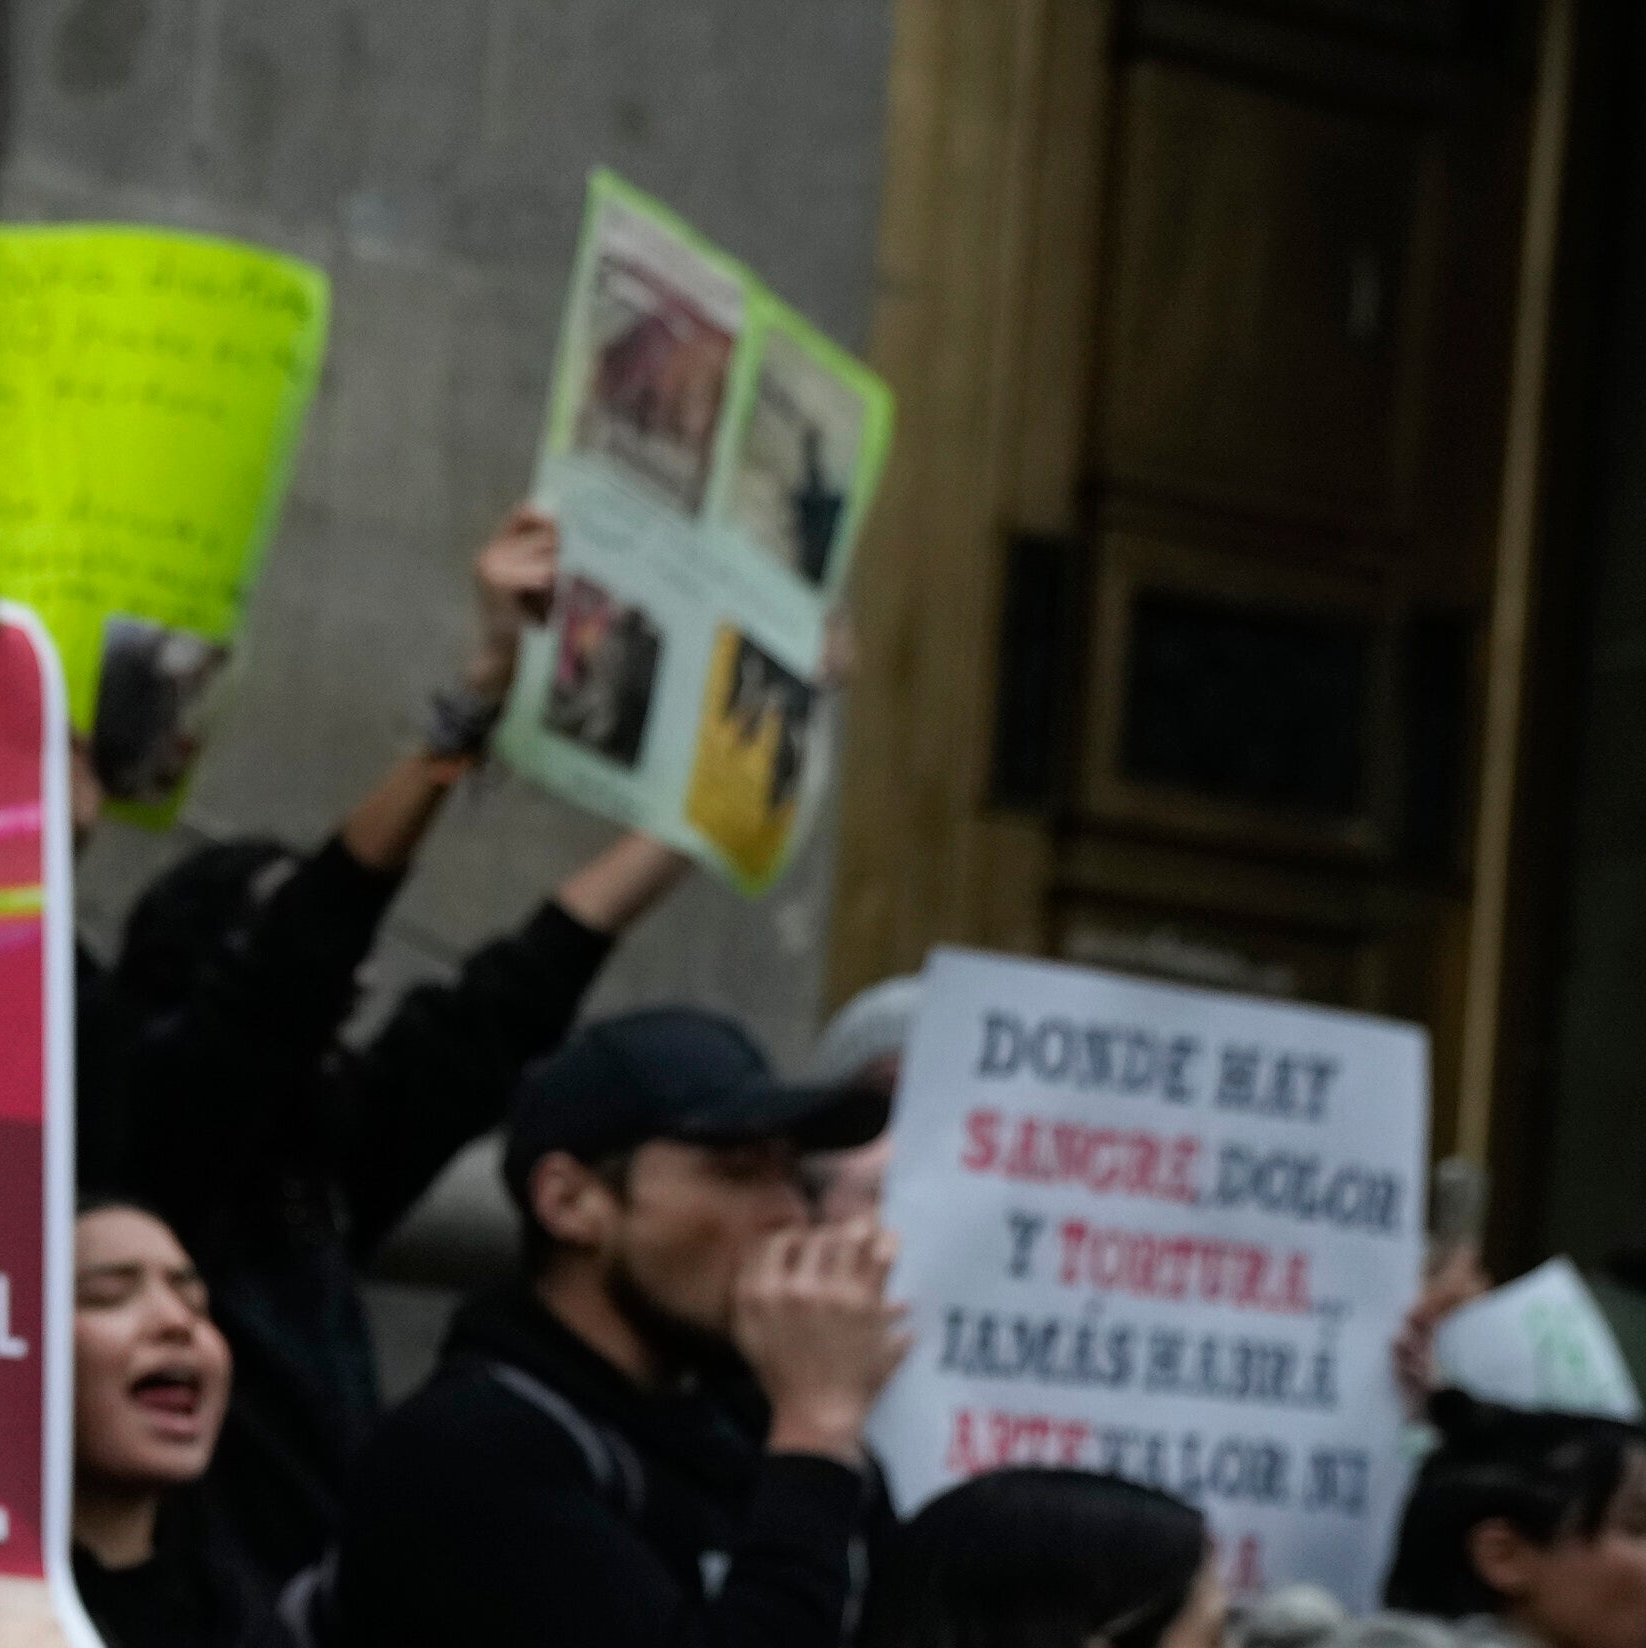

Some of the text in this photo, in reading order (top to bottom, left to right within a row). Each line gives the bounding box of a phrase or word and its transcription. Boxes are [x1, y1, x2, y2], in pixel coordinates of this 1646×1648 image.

[976, 1007, 1342, 1120] DONDE HAY
[1006, 1212, 1045, 1282] Y
